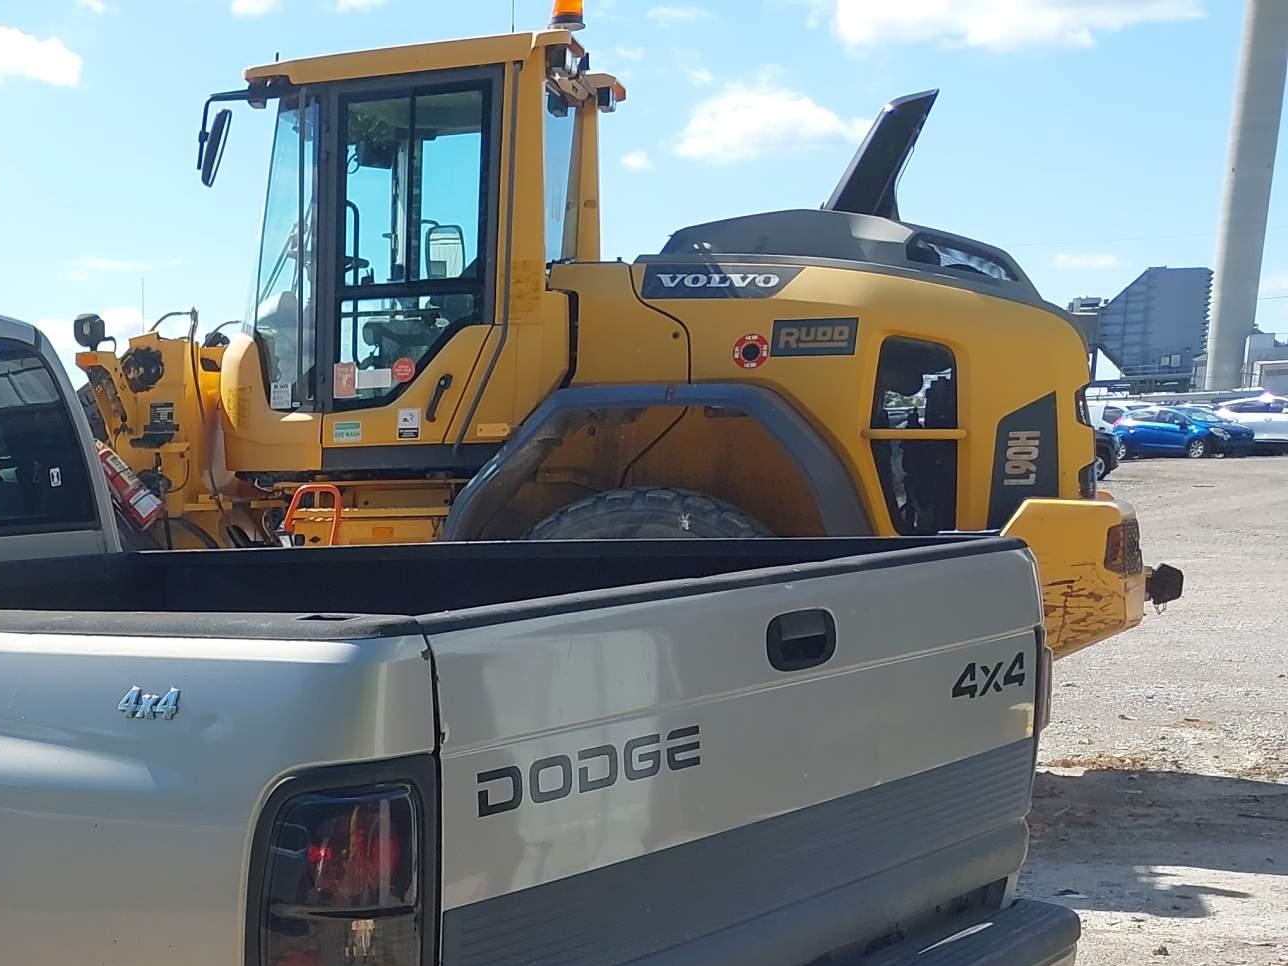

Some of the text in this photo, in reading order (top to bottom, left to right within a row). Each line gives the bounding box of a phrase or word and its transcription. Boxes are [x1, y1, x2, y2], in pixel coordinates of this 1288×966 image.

[657, 274, 779, 288] VOLVO
[778, 325, 850, 349] RUDD
[1003, 431, 1041, 485] L90H
[477, 725, 701, 817] DODGE
